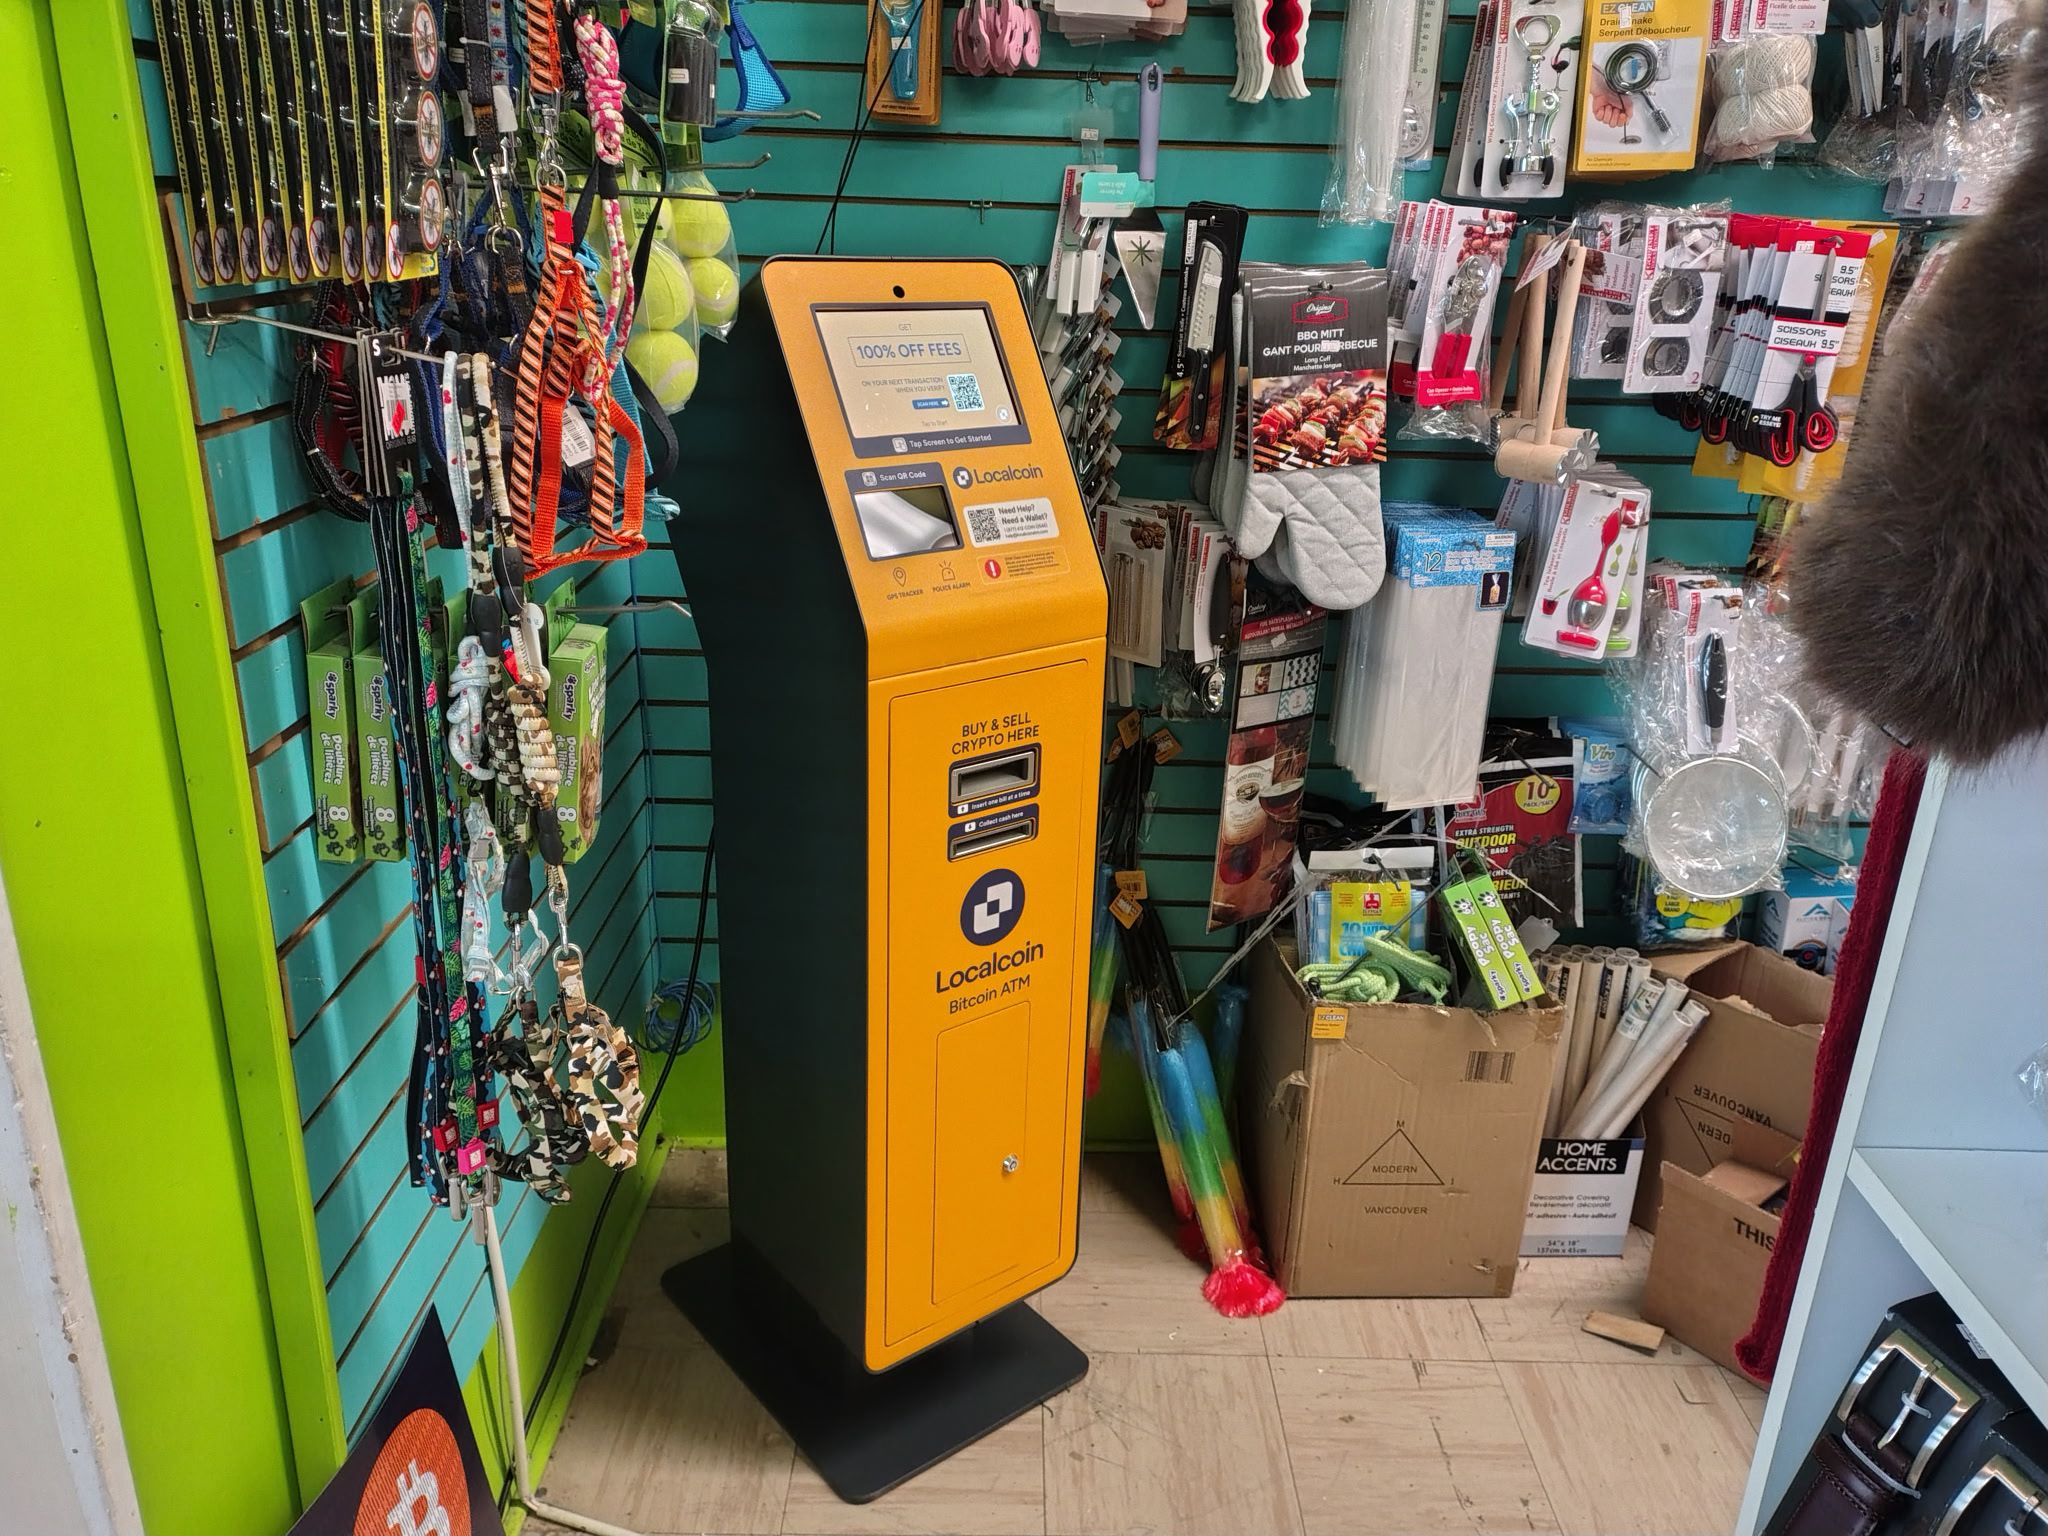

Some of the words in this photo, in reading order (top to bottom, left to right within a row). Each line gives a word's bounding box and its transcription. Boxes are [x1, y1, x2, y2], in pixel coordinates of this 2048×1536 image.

[1602, 3, 1617, 14] EZ
[1600, 17, 1621, 26] Drai
[1631, 17, 1653, 25] nake
[1810, 20, 1816, 29] 2
[1599, 29, 1634, 38] Serpent
[1635, 25, 1691, 36] Déboucheur
[1916, 192, 1925, 205] 2
[1961, 196, 1971, 209] 2
[899, 323, 912, 331] GET
[1297, 331, 1319, 341] BBQ
[1320, 328, 1345, 338] MITT
[1776, 325, 1828, 337] SCISSORS
[372, 339, 381, 356] S
[857, 344, 896, 359] 100%
[898, 343, 924, 357] OFF
[928, 342, 962, 356] FEES
[1263, 346, 1292, 357] GANT
[1293, 344, 1321, 354] POUR
[1336, 338, 1378, 350] RBECUE
[1773, 337, 1817, 348] CISEAUX
[1820, 339, 1840, 350] 9.5"
[1176, 358, 1185, 378] 4.5"
[1293, 363, 1323, 371] Manchette
[1323, 362, 1342, 370] longue
[1691, 371, 1700, 384] 2
[909, 440, 922, 449] Tap
[923, 438, 945, 447] Screen
[968, 434, 992, 443] Started
[880, 474, 897, 482] Scan
[897, 472, 908, 480] QR
[973, 463, 1044, 484] Localcoin
[998, 506, 1016, 515] Need
[1017, 503, 1035, 513] Help?
[1001, 516, 1019, 525] Need
[1025, 513, 1048, 522] Wallet?
[1424, 552, 1442, 572] 12
[886, 592, 898, 600] GPS
[899, 588, 923, 599] TRACKER
[932, 584, 951, 592] POLICE
[952, 581, 971, 590] ALARM
[325, 682, 339, 719] sparky
[371, 685, 386, 722] sparky
[561, 684, 579, 721] sparky
[962, 721, 987, 737] BUY
[991, 718, 1000, 730] &
[1002, 712, 1031, 728] SELL
[319, 732, 330, 745] de
[366, 734, 377, 747] de
[951, 733, 1004, 755] CRYPTO
[1007, 725, 1040, 742] HERE
[323, 748, 336, 783] litières
[332, 734, 346, 785] Doublure
[369, 750, 382, 785] litières
[377, 737, 393, 787] Doublure
[563, 734, 578, 787] Doublure
[1527, 781, 1550, 799] 10
[971, 801, 987, 810] Insert
[998, 796, 1008, 804] bill
[1018, 789, 1031, 798] time
[328, 805, 350, 822] 8
[374, 806, 396, 823] 8
[556, 805, 577, 822] 8
[978, 818, 998, 828] Collect
[998, 815, 1010, 823] cash
[1011, 811, 1024, 819] here
[1572, 816, 1579, 825] 2
[1479, 824, 1514, 834] STRENGTH
[1455, 833, 1517, 849] OUTDOOR
[1490, 846, 1509, 855] BAGS
[1479, 932, 1495, 954] Sac
[1491, 919, 1516, 959] Poopy
[1503, 925, 1520, 947] Sac
[1466, 926, 1491, 967] Poopy
[936, 941, 1044, 994] Localcoin
[1513, 962, 1531, 988] sparky
[1489, 969, 1506, 996] sparky
[949, 988, 997, 1015] Bitcoin
[1000, 974, 1031, 997] ATM
[1693, 1084, 1772, 1128] VANCOUVER
[1396, 1120, 1405, 1128] M
[1698, 1120, 1731, 1145] DERN
[1556, 1143, 1607, 1156] HOME
[1372, 1165, 1418, 1173] MODERN
[1538, 1157, 1617, 1172] ACCENTS
[1364, 1206, 1428, 1215] VANCOUVER
[1734, 1218, 1776, 1251] THIS
